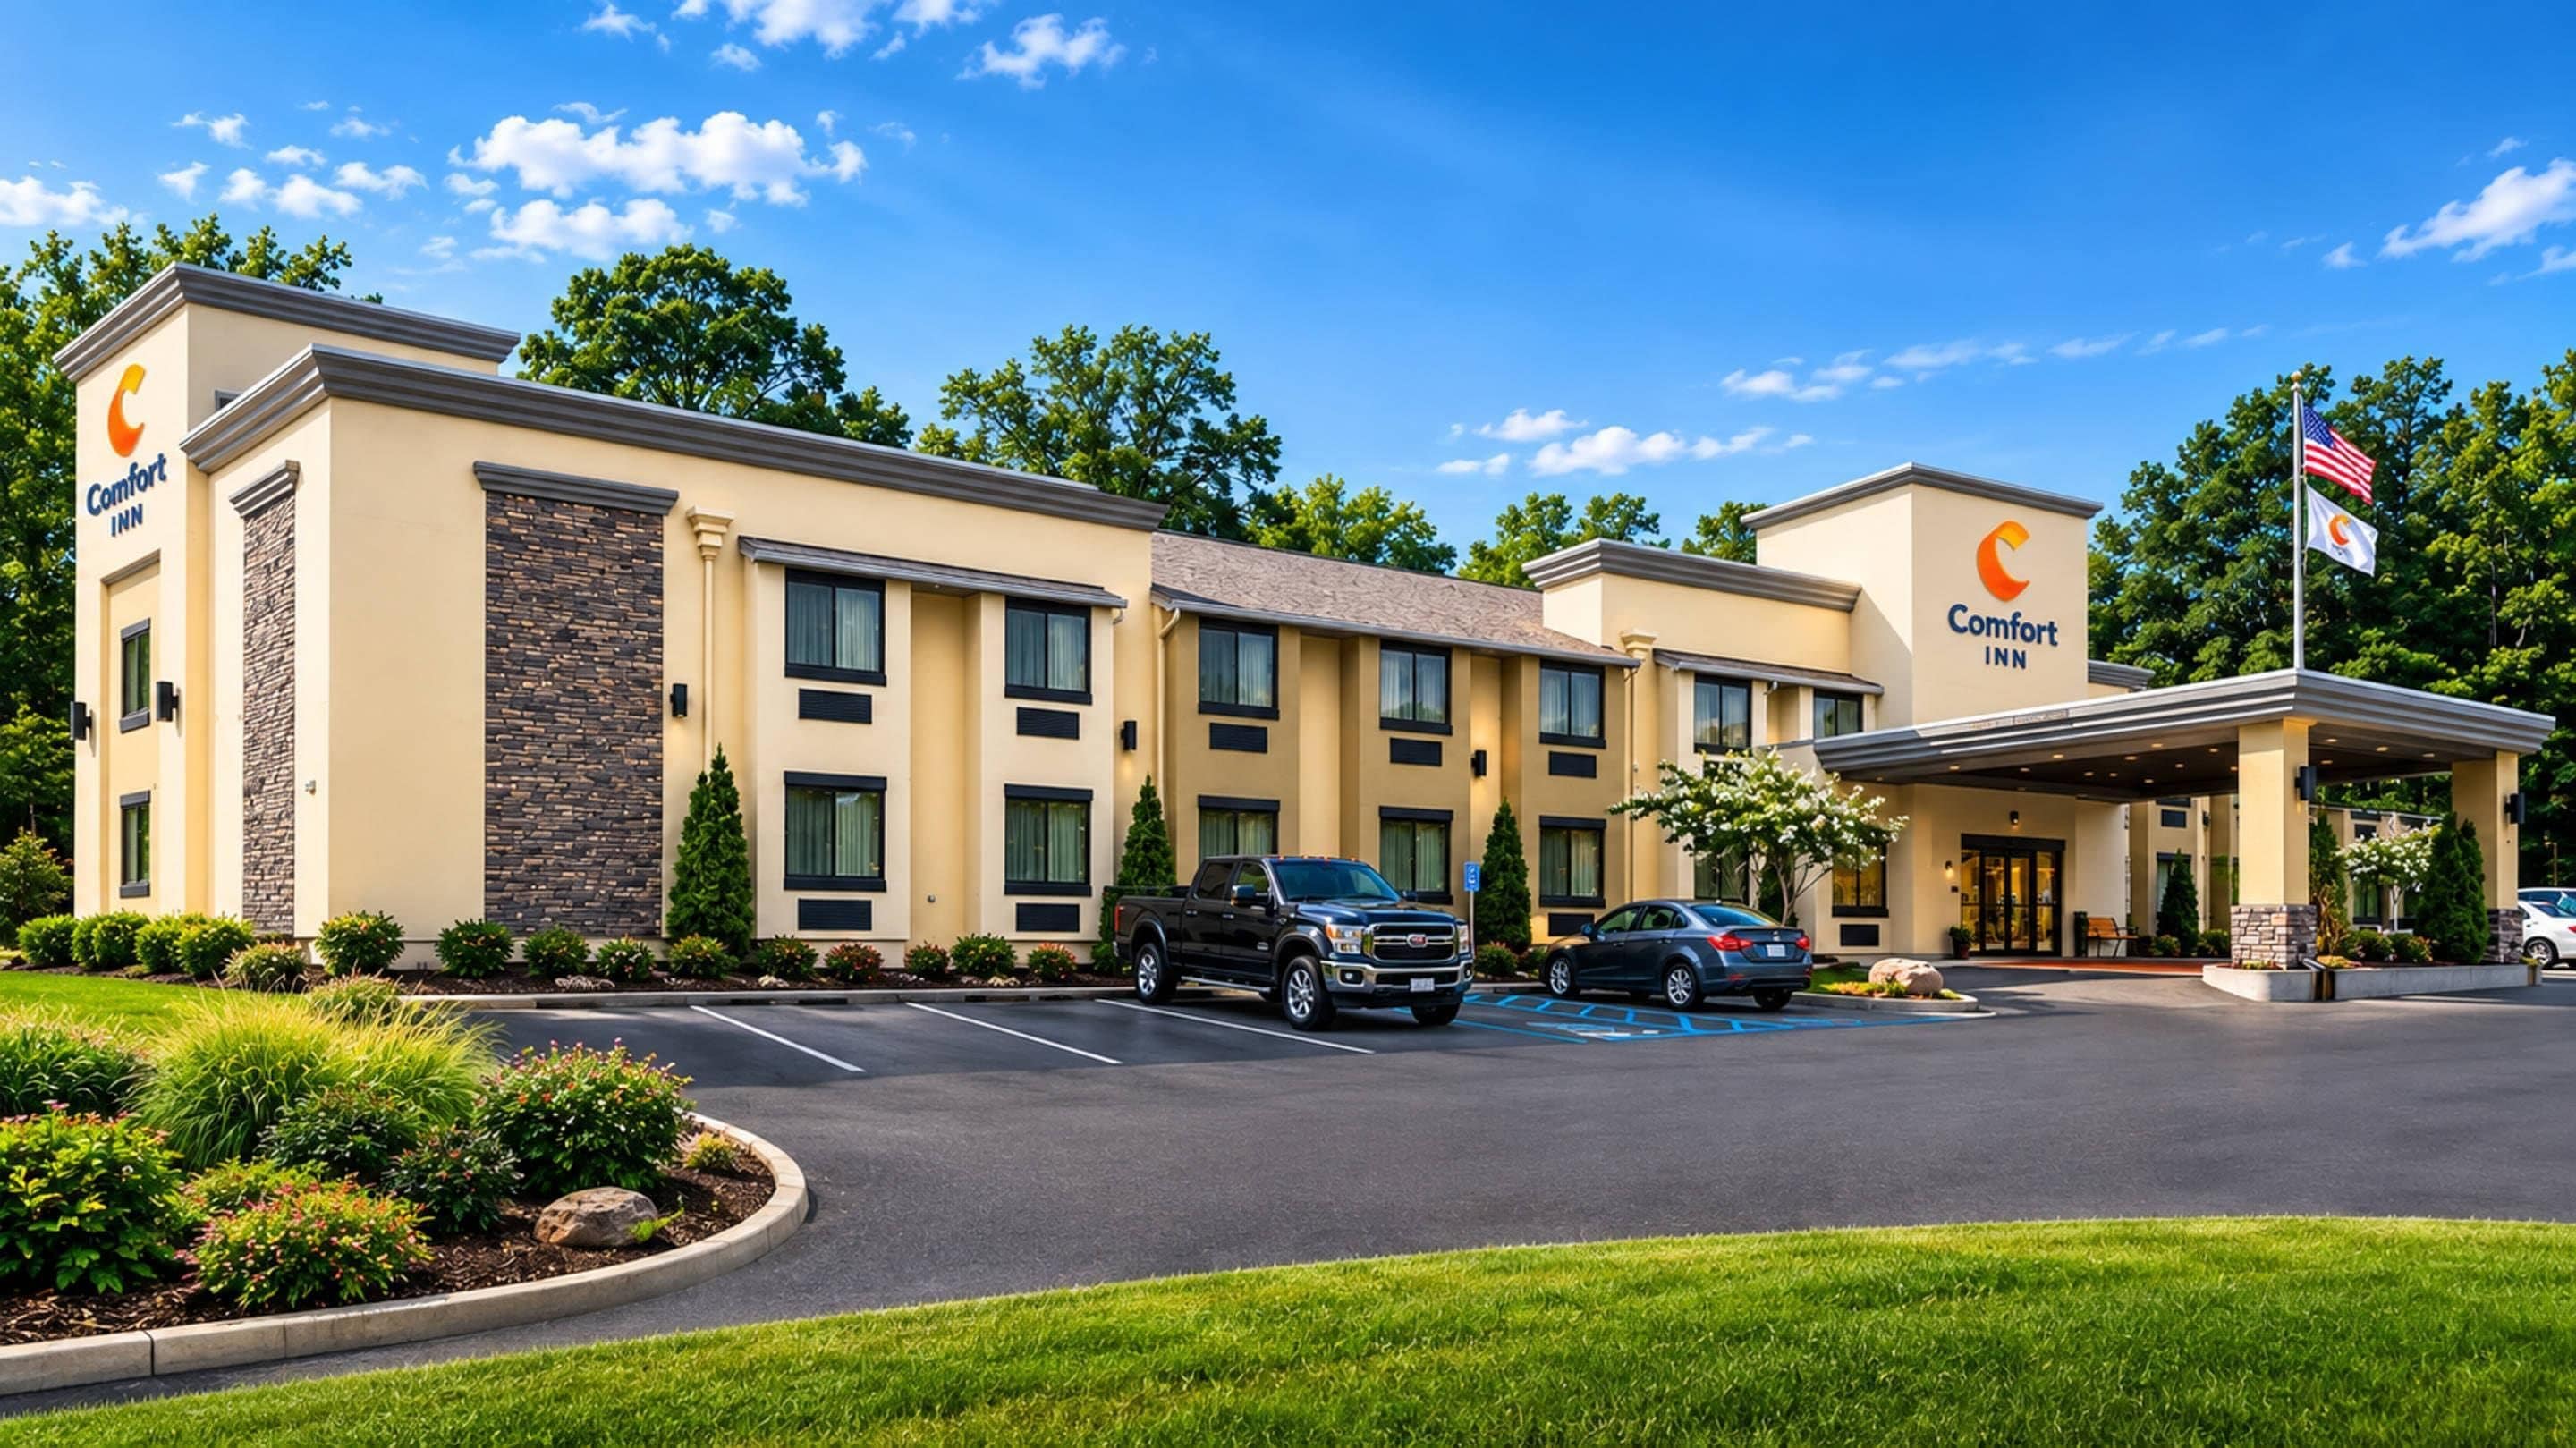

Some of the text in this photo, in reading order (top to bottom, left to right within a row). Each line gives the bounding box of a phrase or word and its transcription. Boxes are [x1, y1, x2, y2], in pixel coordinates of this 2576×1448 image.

[87, 453, 167, 517] Comfort
[110, 503, 143, 537] INN
[1948, 604, 2058, 647] Comfort
[1985, 646, 2026, 670] INN
